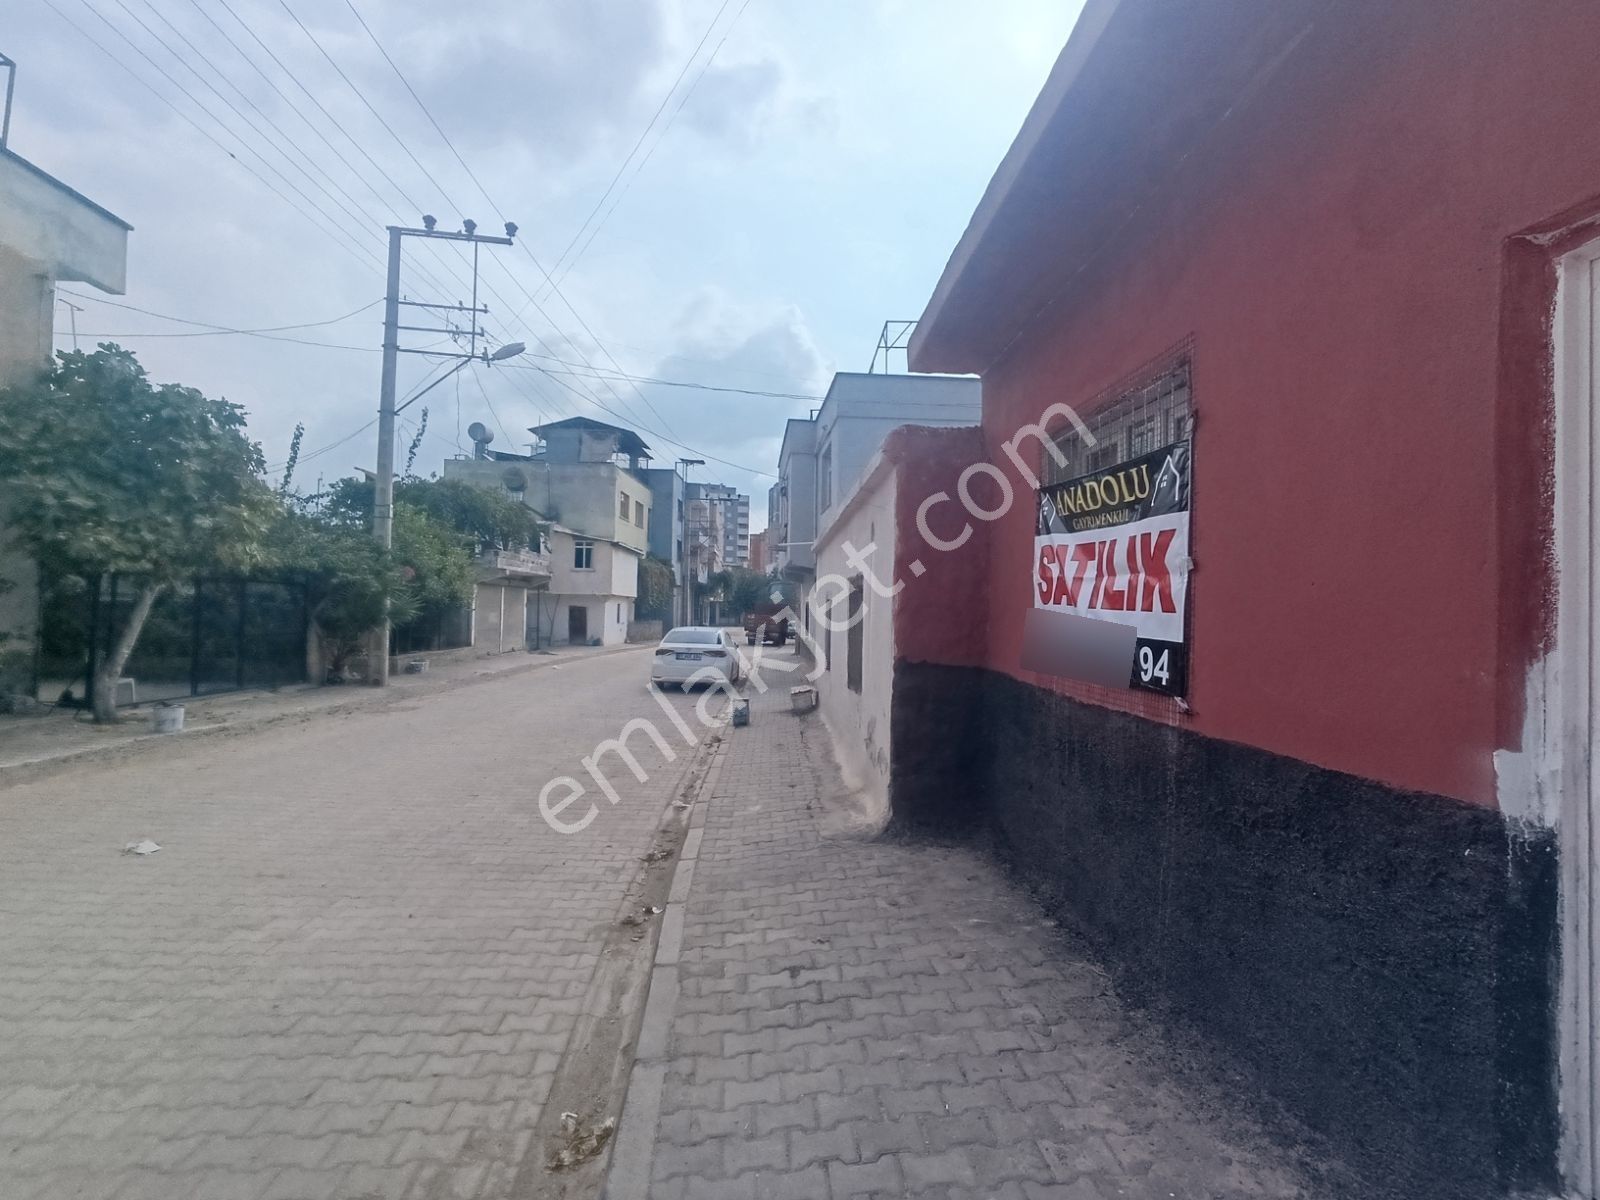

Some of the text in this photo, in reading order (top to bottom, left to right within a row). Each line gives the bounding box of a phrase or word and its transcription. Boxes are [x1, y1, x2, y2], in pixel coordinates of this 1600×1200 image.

[1057, 464, 1149, 516] ANADOLU
[1038, 529, 1176, 613] SATILIK
[1139, 646, 1169, 685] 94
